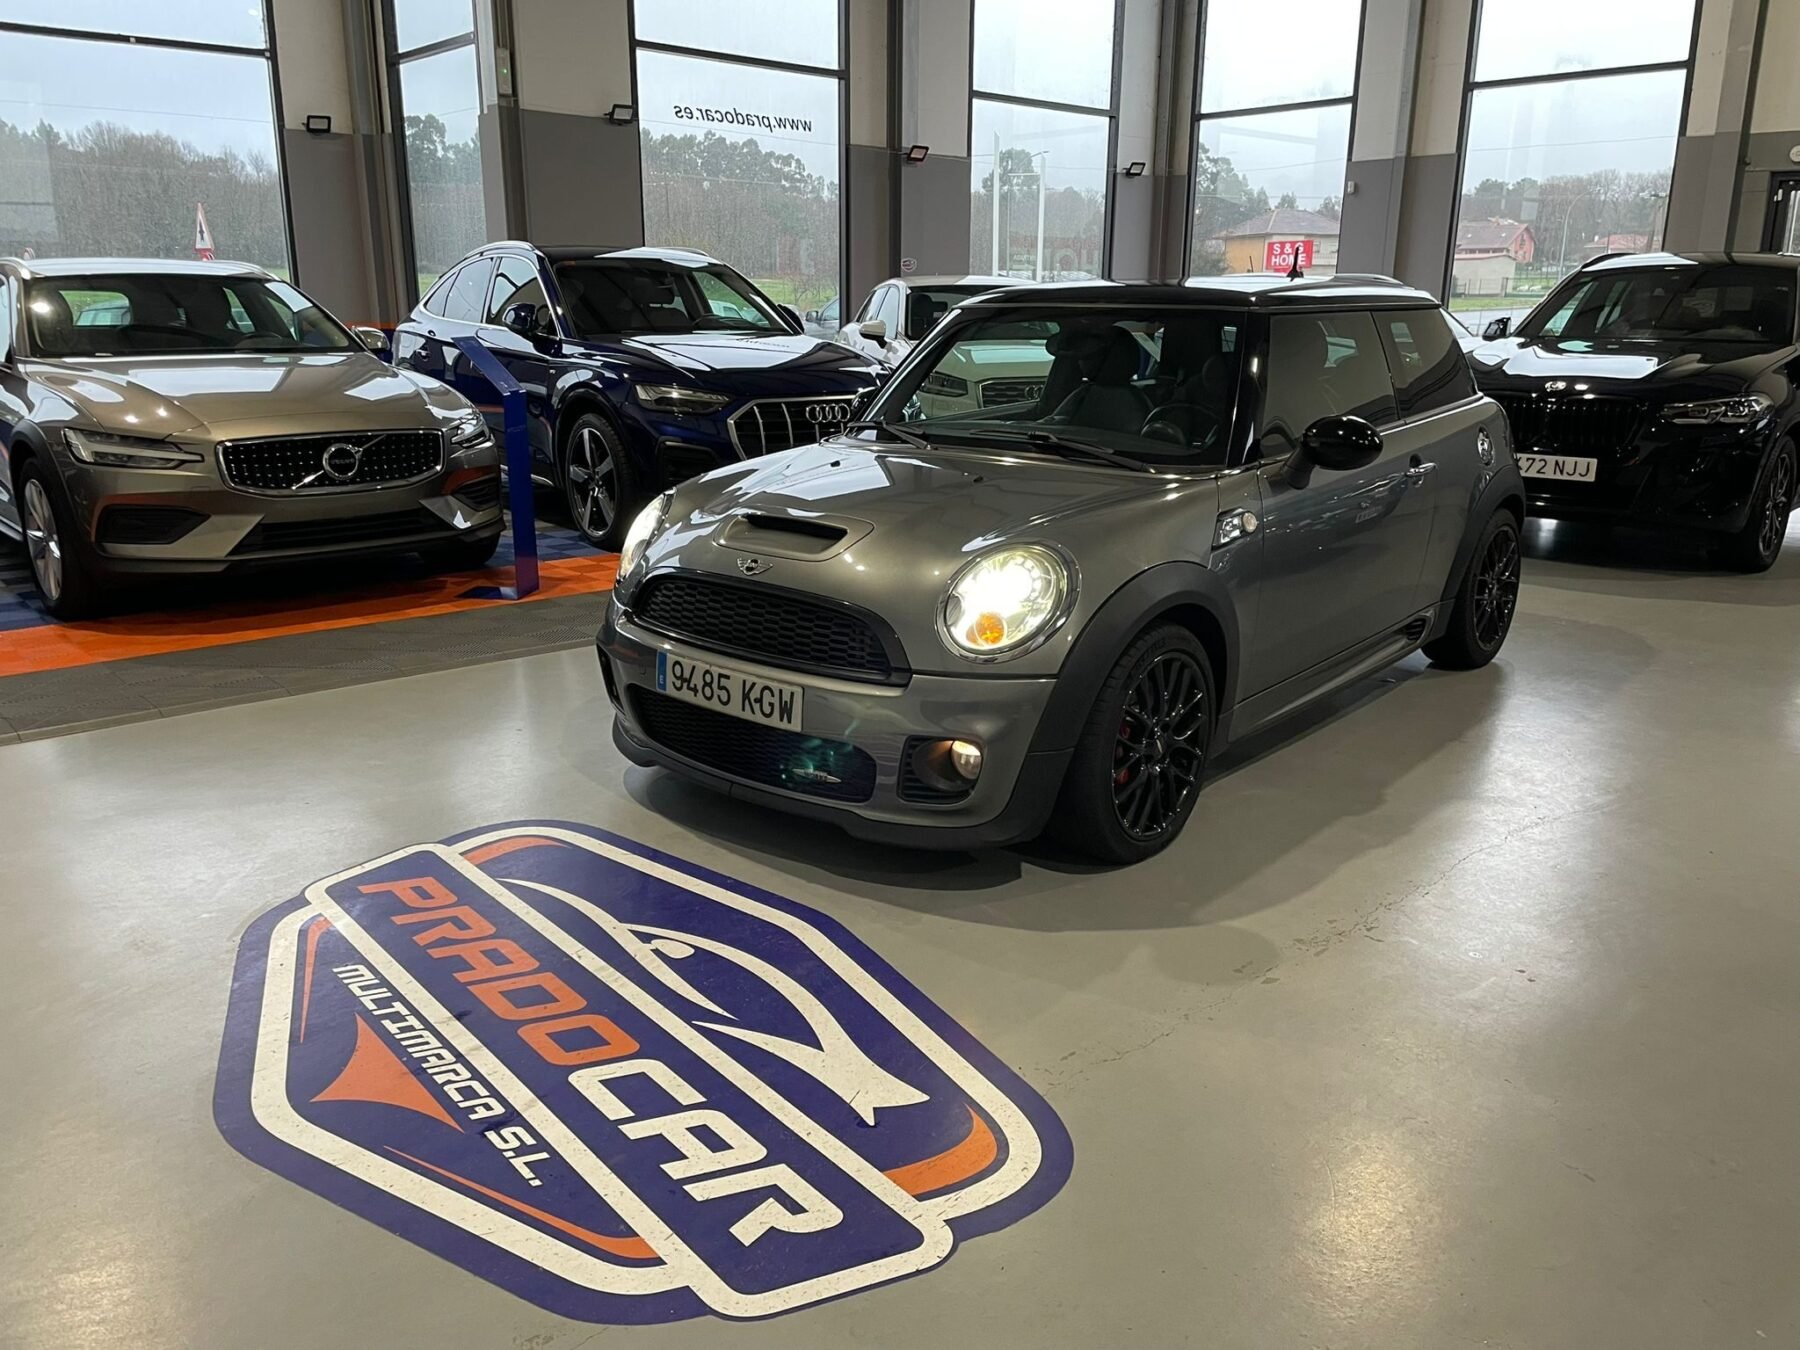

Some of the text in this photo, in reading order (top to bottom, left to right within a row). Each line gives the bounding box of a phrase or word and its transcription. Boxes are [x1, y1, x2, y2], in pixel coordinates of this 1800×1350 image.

[1273, 243, 1281, 254] S
[1284, 242, 1292, 254] &
[1519, 457, 1591, 477] 72 NJJ
[672, 660, 795, 725] 9485 KGW
[332, 963, 551, 1188] MULTIMARCA S.L.
[358, 876, 844, 1247] PRADOCAR
